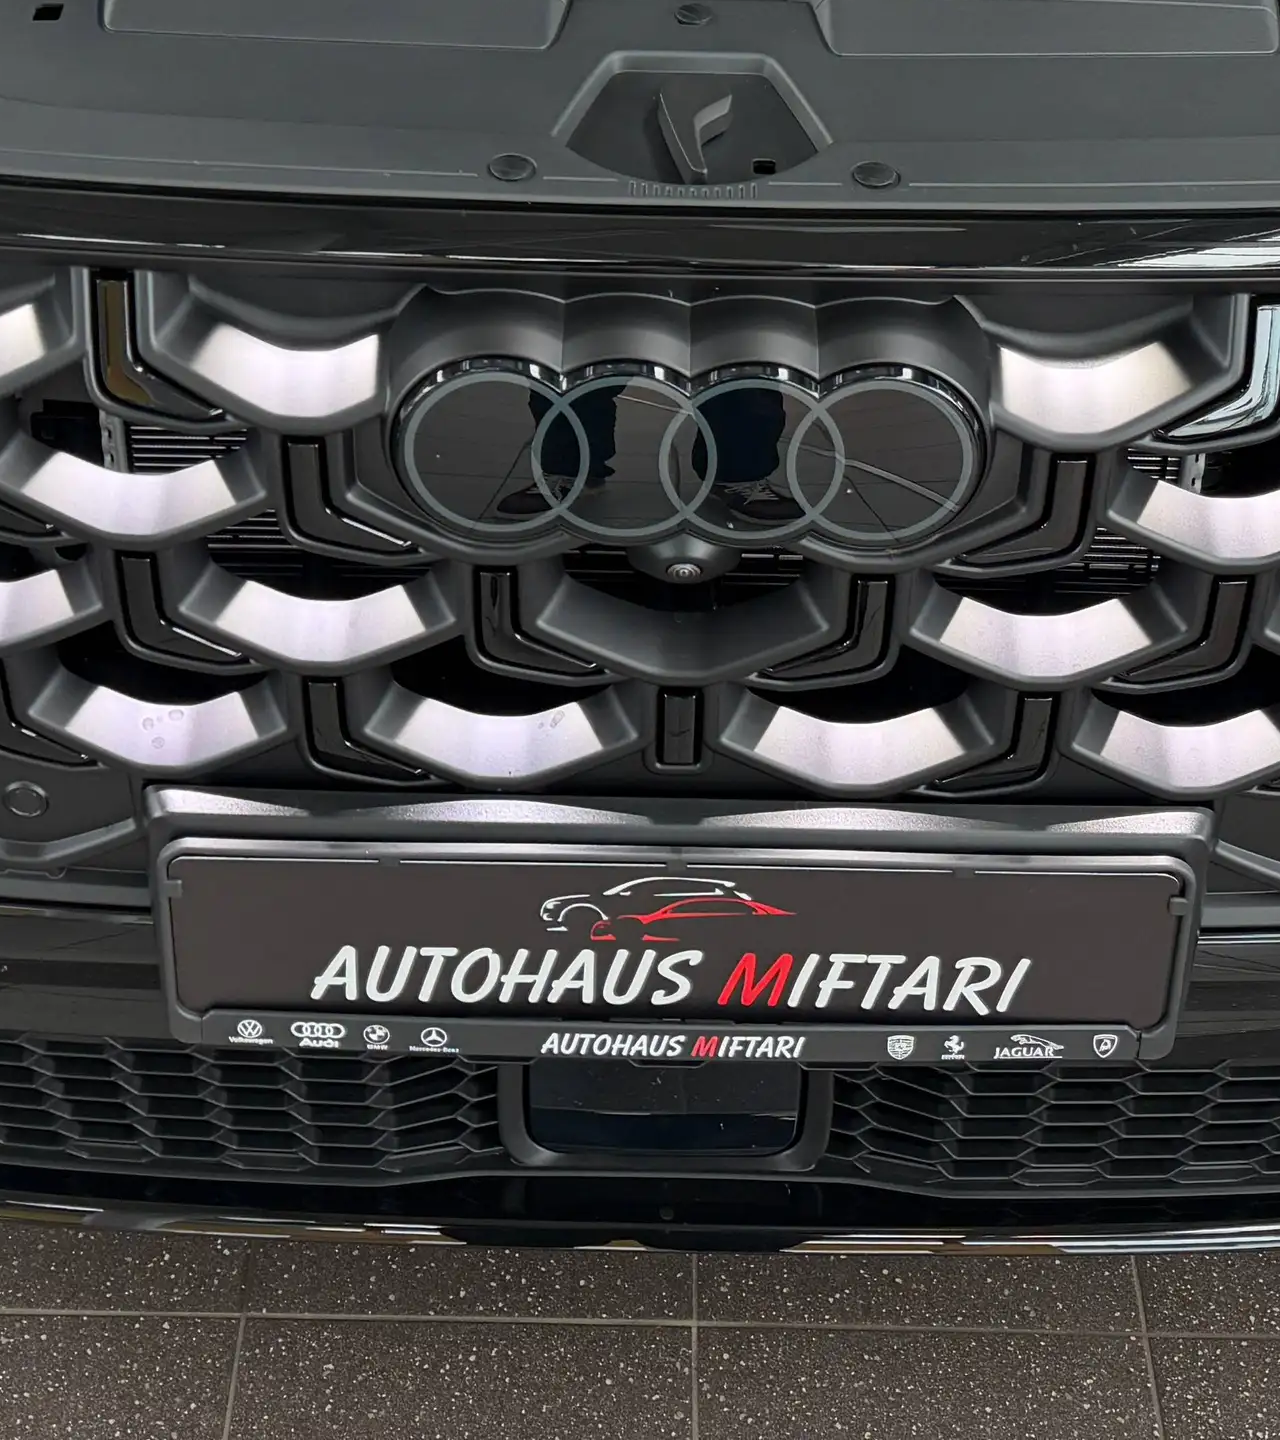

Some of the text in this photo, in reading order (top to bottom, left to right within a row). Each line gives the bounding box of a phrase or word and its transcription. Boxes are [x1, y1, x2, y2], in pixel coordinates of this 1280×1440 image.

[310, 944, 1032, 1016] AUTOHAUS MIFTARI
[541, 1032, 806, 1059] AUTOHAUS MIFTARI
[993, 1046, 1056, 1059] JAGUAR
